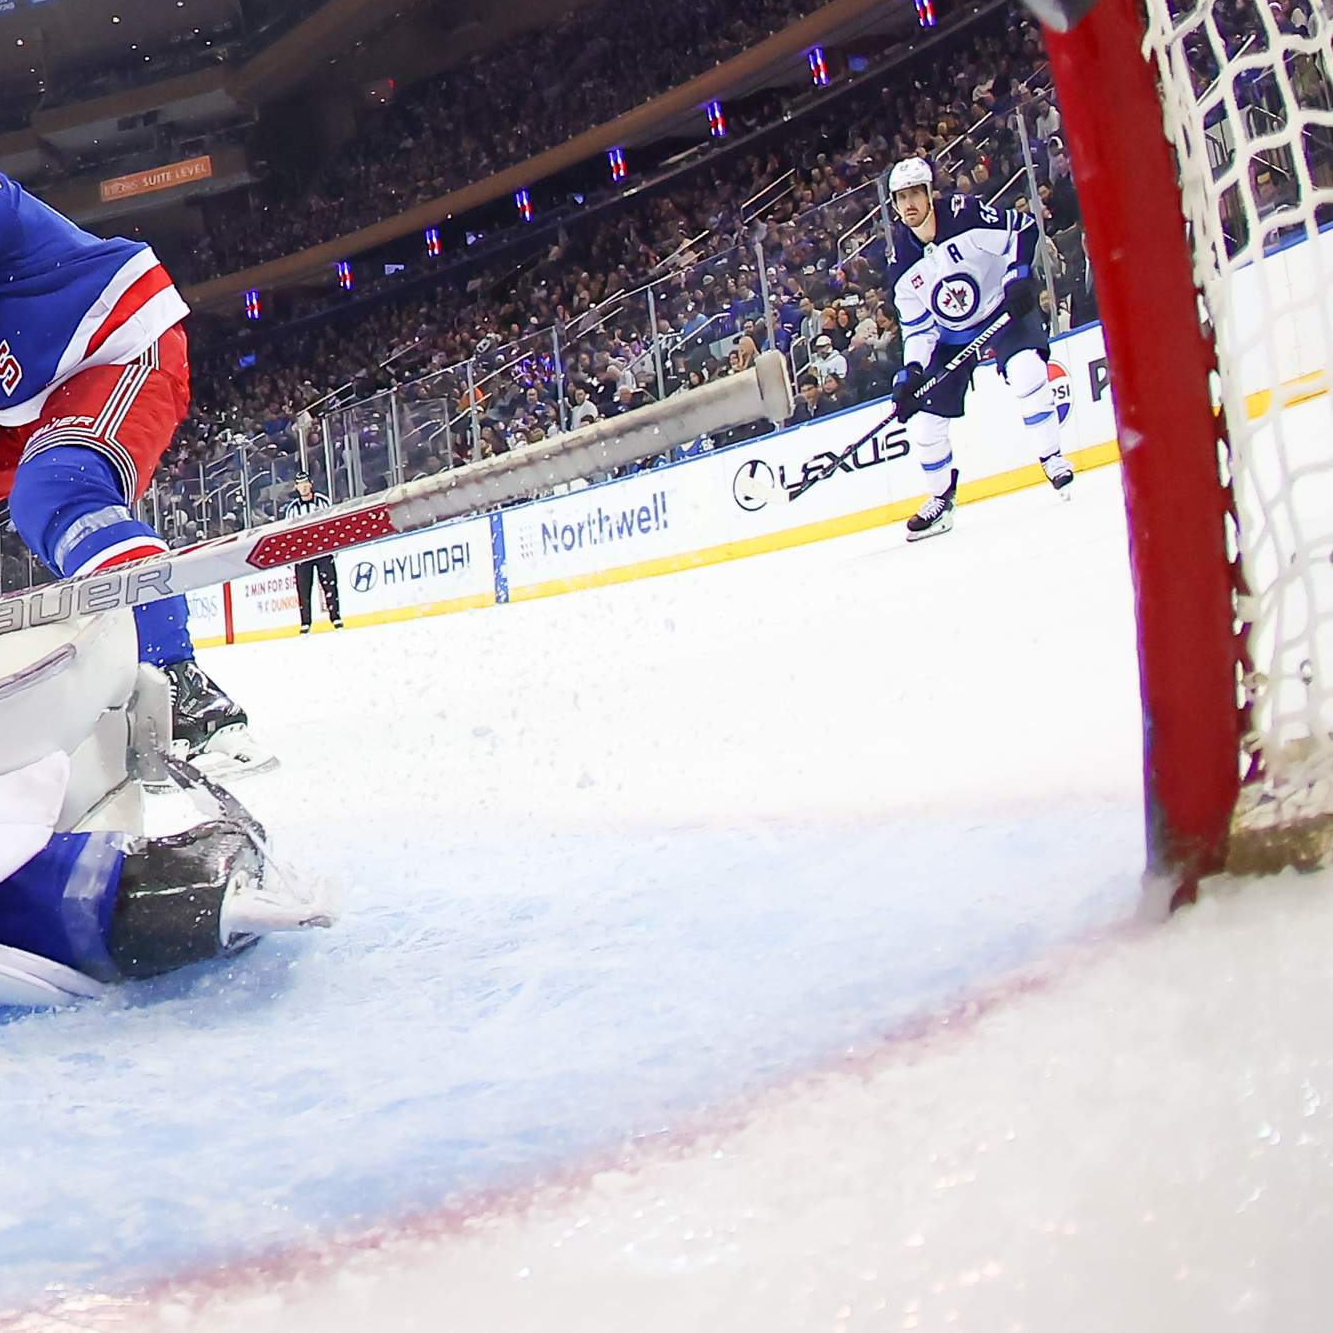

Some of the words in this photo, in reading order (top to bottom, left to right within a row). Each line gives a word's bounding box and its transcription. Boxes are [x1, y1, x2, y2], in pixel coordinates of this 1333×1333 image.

[142, 171, 171, 187] SUITE
[175, 163, 208, 179] LEVEL
[946, 242, 965, 265] A
[778, 427, 911, 491] LEXUS
[541, 490, 669, 556] Northwell
[383, 542, 471, 586] HYUNDAI
[250, 581, 267, 597] MIN
